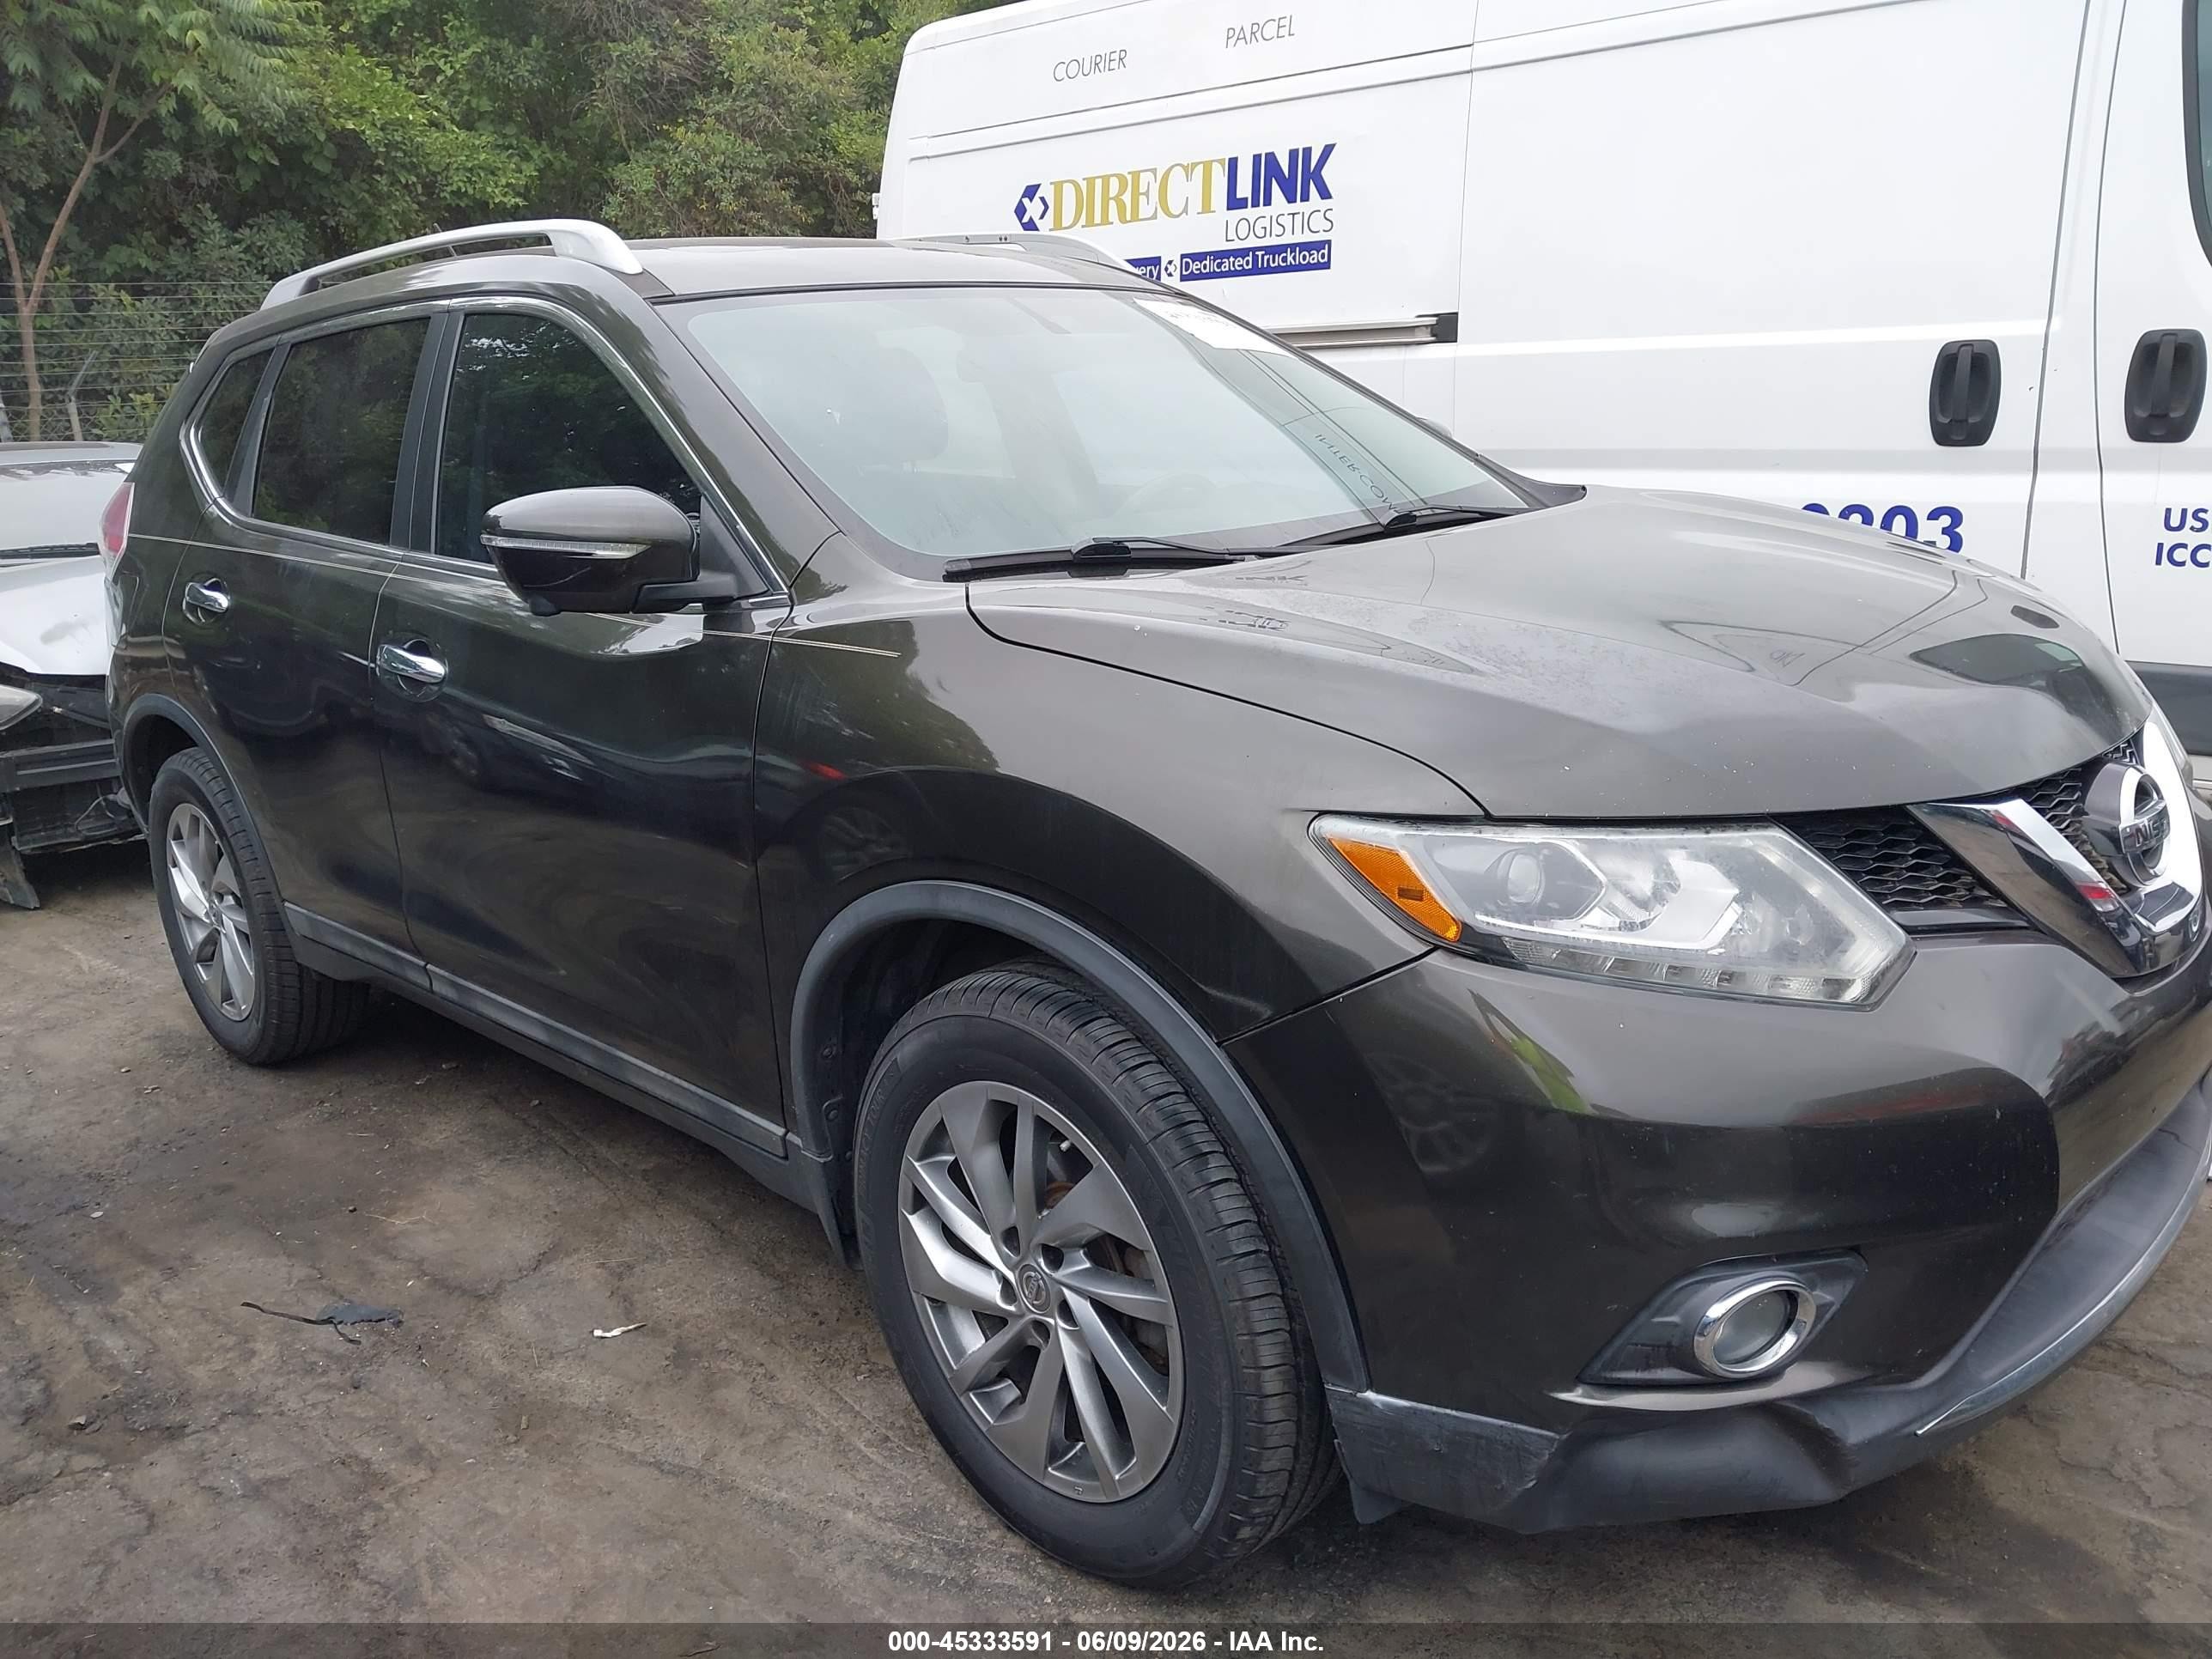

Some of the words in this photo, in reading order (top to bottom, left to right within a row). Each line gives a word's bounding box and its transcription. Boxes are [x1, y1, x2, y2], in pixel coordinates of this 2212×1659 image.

[1225, 15, 1296, 49] PARCEL
[1053, 49, 1127, 82] COURIER
[1225, 209, 1334, 242] LOGISTICS
[1182, 255, 1252, 275] Dedicated
[1256, 246, 1328, 269] Truckload
